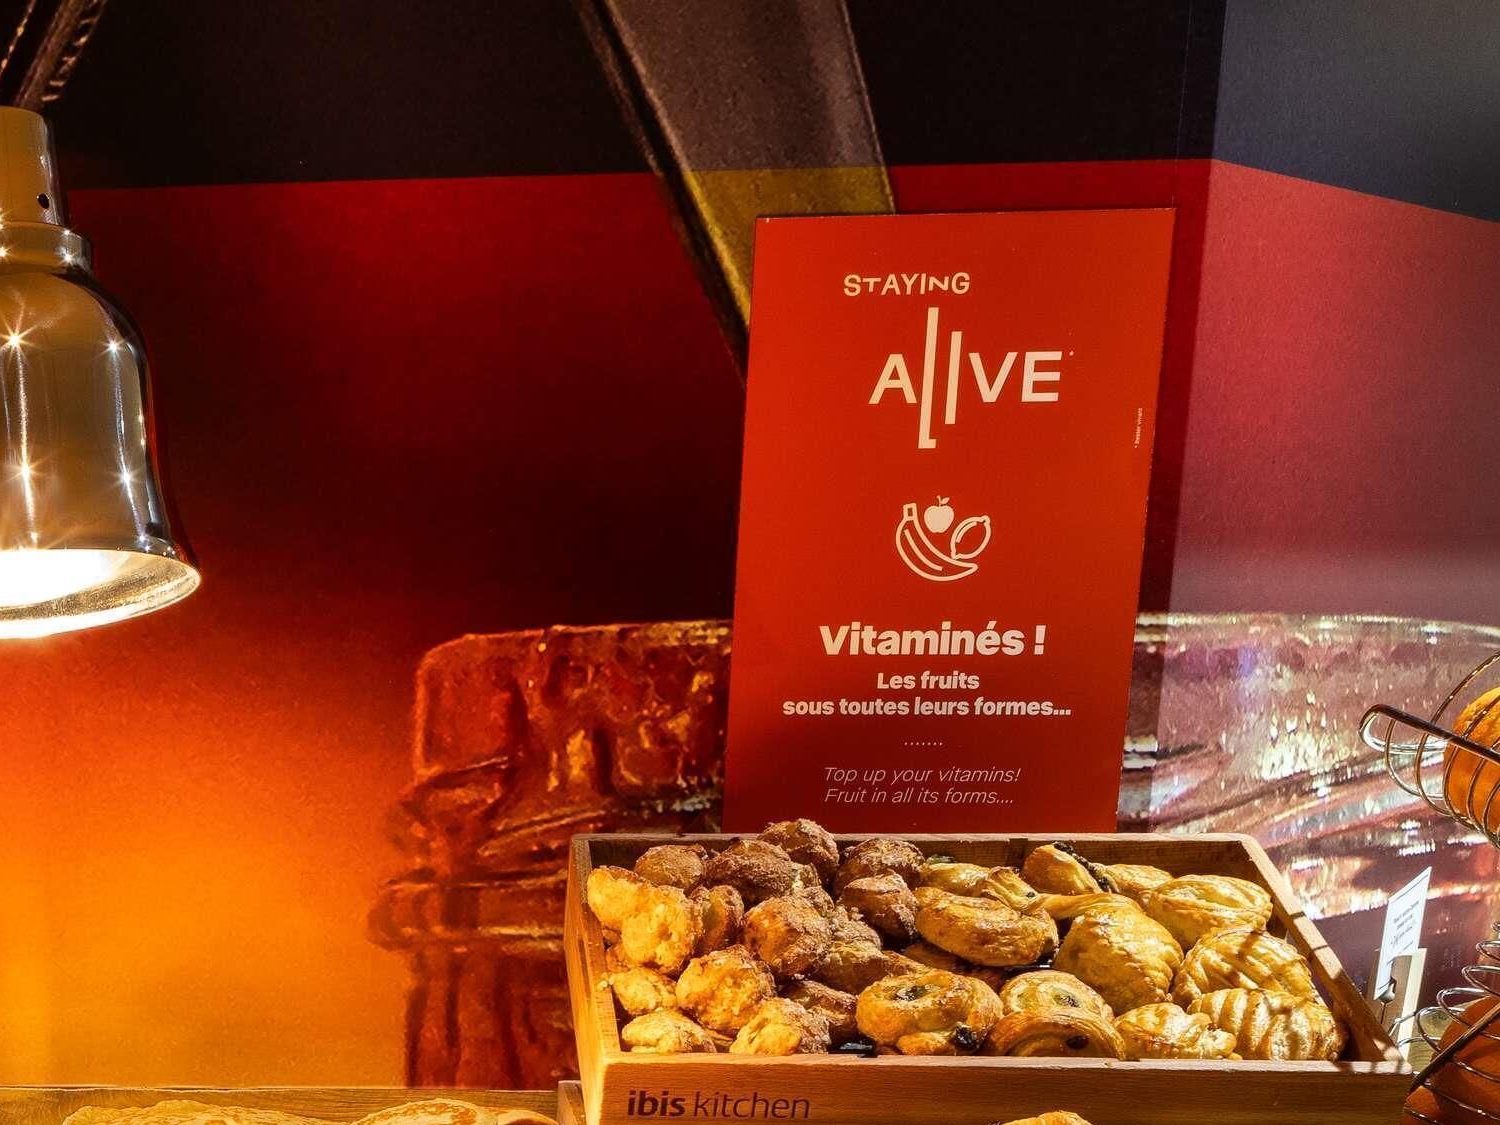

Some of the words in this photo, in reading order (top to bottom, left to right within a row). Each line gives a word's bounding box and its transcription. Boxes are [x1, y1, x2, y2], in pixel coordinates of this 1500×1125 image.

[842, 271, 971, 297] STAYING
[819, 620, 1025, 656] Vitaminés
[877, 671, 916, 690] Les
[920, 670, 980, 690] fruits
[782, 701, 834, 717] sous
[839, 698, 910, 716] toutes
[914, 698, 970, 716] leurs
[973, 697, 1071, 716] formes...
[824, 767, 858, 786] Top
[862, 771, 886, 786] up
[890, 771, 933, 786] your
[938, 767, 1021, 783] vitamins!
[824, 788, 866, 804] Fruit
[870, 789, 887, 804] in
[892, 788, 913, 804] all
[918, 788, 940, 804] its
[627, 1090, 687, 1118] ibis
[694, 1091, 811, 1119] kitchen
